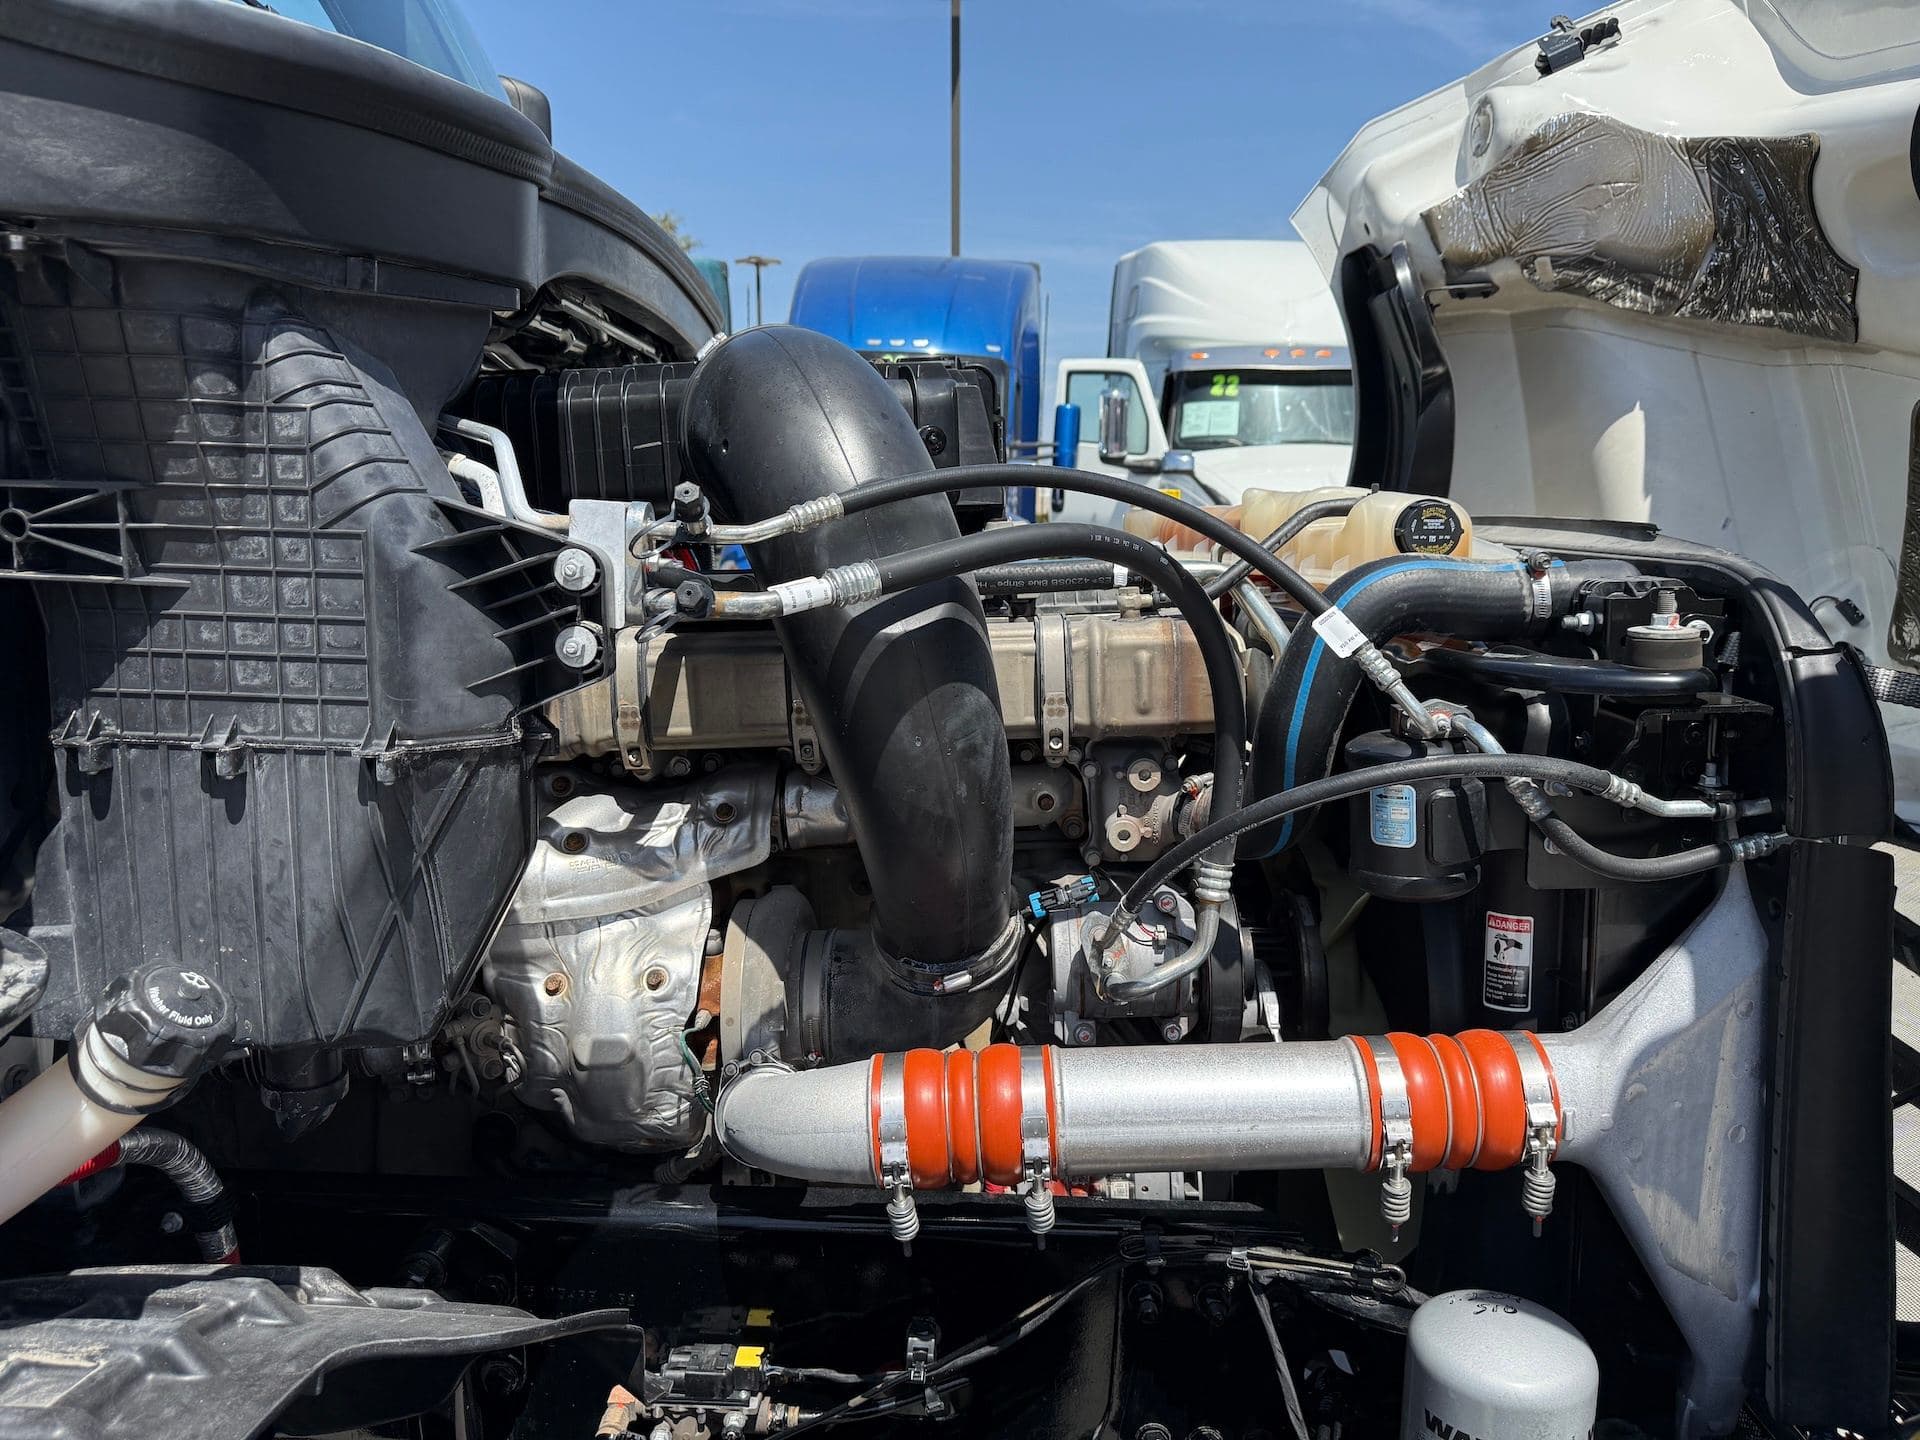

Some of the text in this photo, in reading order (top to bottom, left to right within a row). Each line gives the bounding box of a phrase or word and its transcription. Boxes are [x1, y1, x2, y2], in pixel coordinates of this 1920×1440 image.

[1210, 374, 1240, 397] 22
[1028, 579, 1048, 587] Blue
[1495, 919, 1530, 931] DANGER
[149, 986, 213, 1026] Washer Fluid Only
